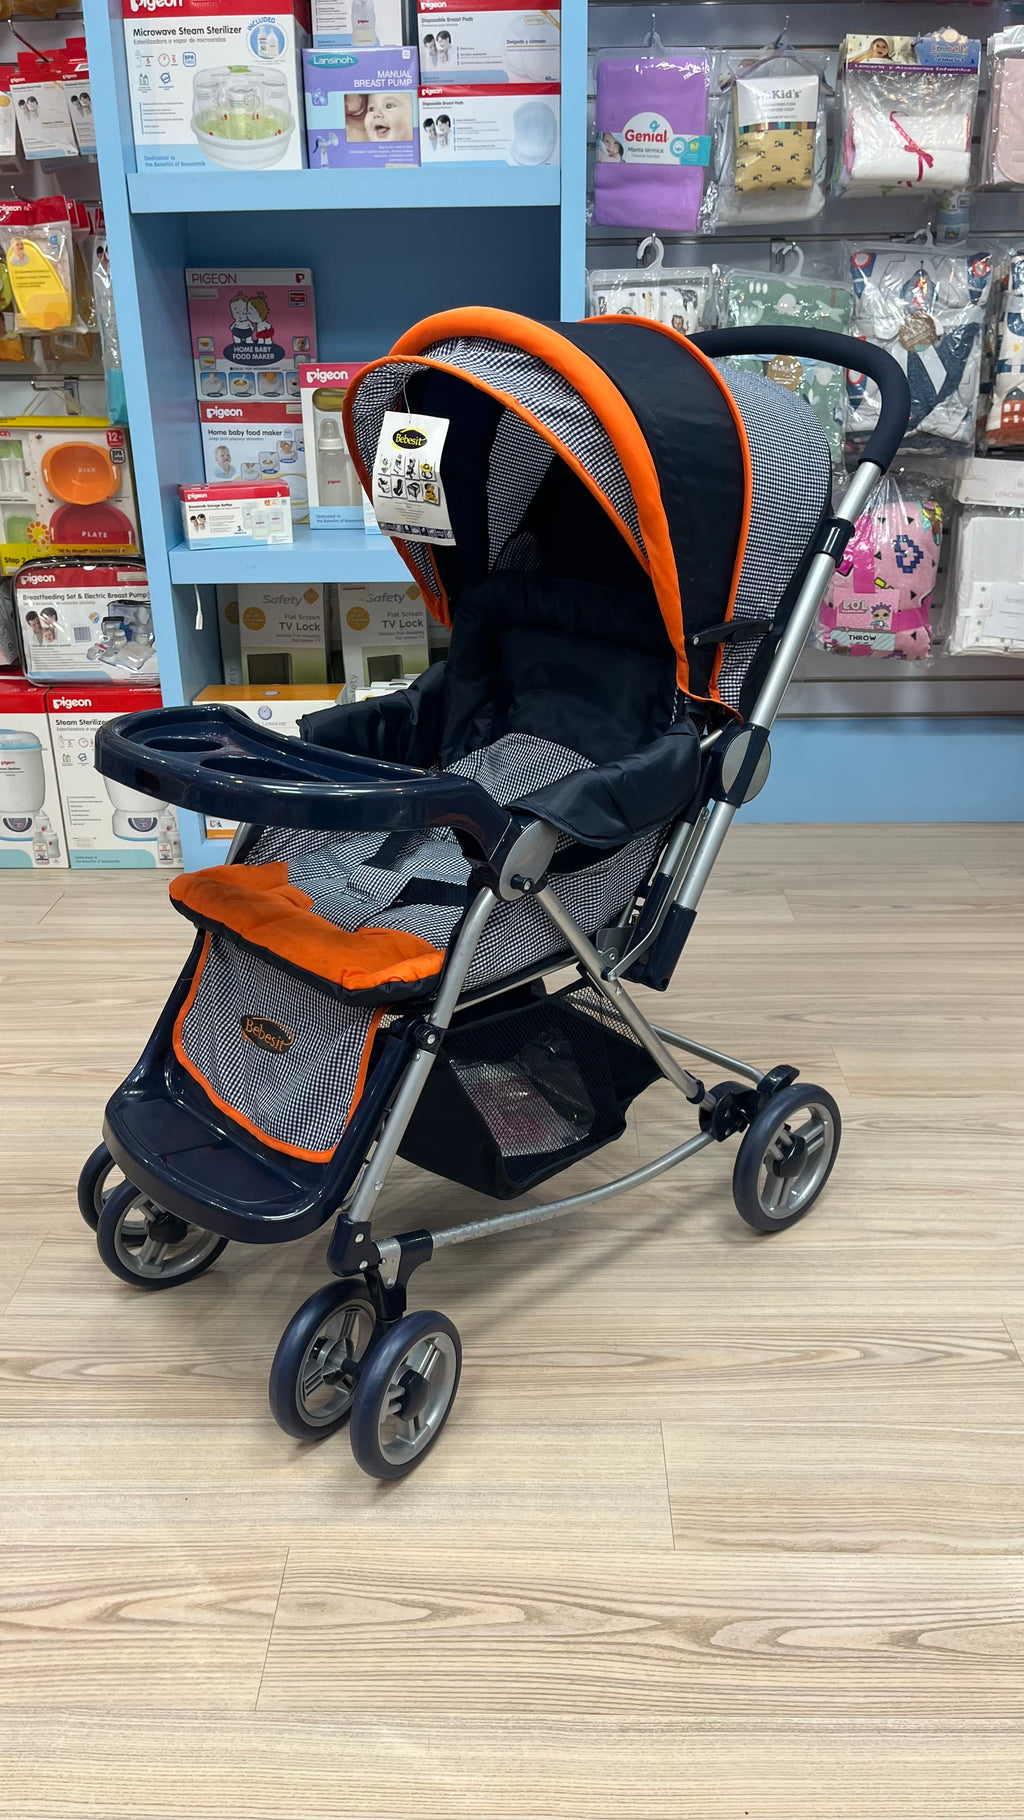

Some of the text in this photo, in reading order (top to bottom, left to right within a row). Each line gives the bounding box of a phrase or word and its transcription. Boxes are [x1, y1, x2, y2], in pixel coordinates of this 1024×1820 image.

[131, 0, 183, 12] pigeon
[420, 0, 447, 10] pigeon
[248, 16, 276, 32] INCLUDED
[133, 26, 242, 36] Microwave Steam Sterilizer
[313, 56, 354, 65] Lansinoh
[378, 70, 412, 78] MANUAL
[354, 79, 412, 88] BREAST PUMP
[422, 88, 443, 96] pigeon
[625, 129, 668, 142] Genial
[192, 273, 237, 284] PIGEON
[306, 368, 348, 383] pigeon
[206, 406, 243, 419] pigeon
[395, 433, 422, 446] Bebesit
[4, 557, 20, 565] Step
[20, 573, 55, 585] pigeon
[262, 595, 302, 606] Safety
[366, 593, 405, 604] Safety
[279, 622, 320, 630] TV Lock
[382, 619, 424, 628] TV Lock
[53, 697, 92, 710] pigeon
[245, 1018, 285, 1052] Bebesit
